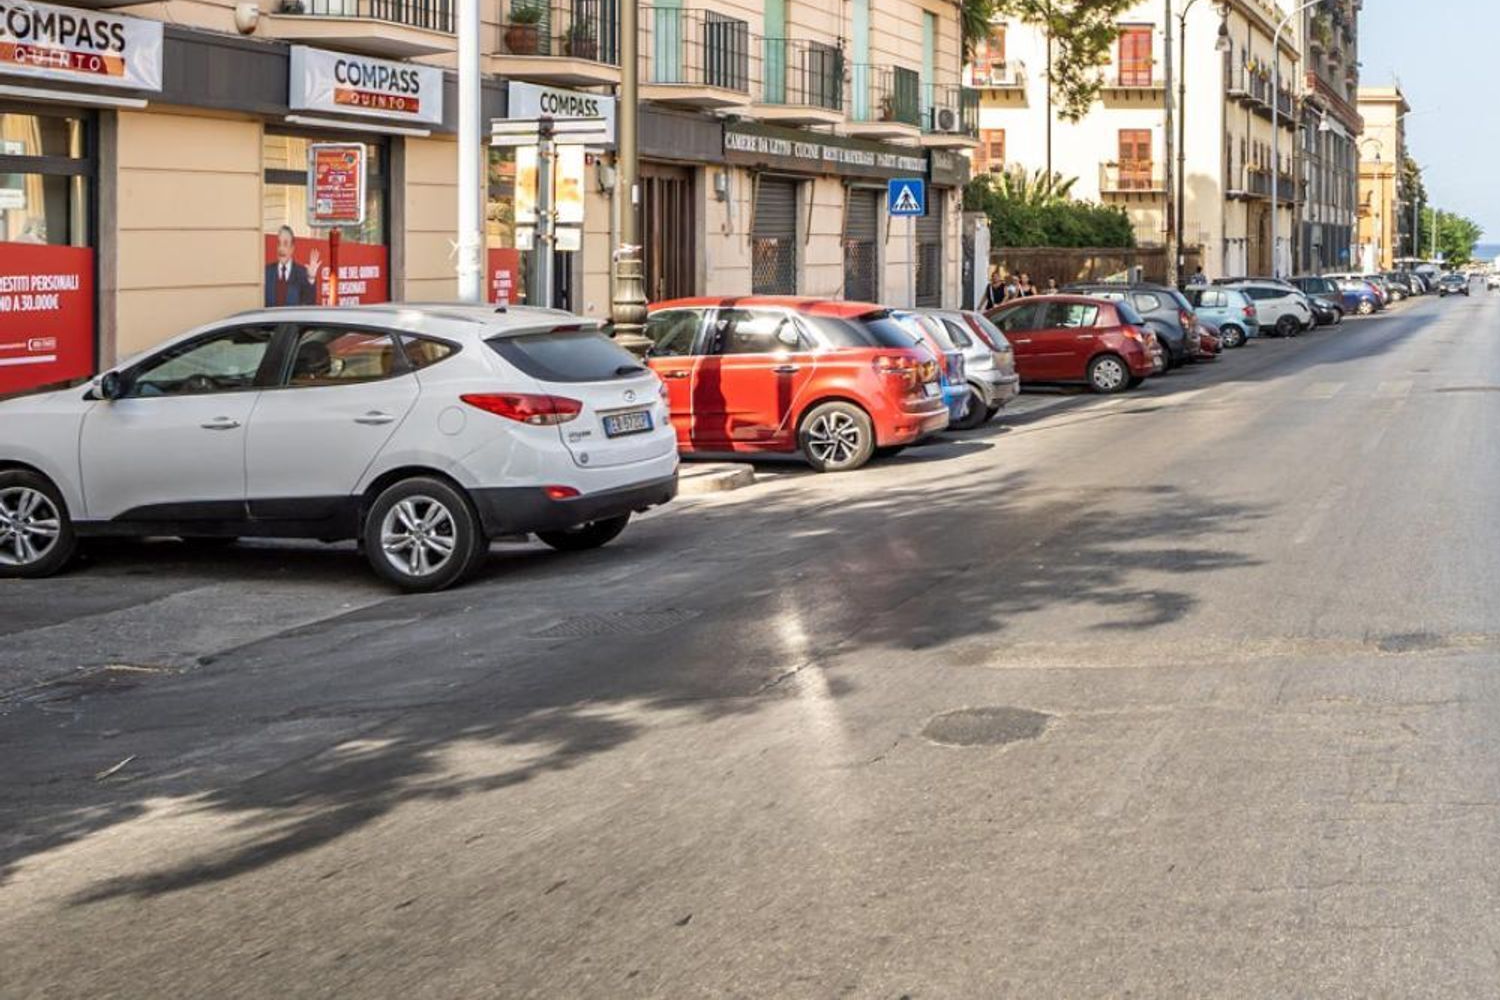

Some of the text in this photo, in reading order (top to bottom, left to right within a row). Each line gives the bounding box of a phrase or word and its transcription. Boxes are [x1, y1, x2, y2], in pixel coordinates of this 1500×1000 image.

[15, 46, 101, 72] QUINTO
[334, 59, 420, 95] COMPASS
[350, 92, 405, 110] QUINTO
[540, 92, 599, 117] COMPASS
[31, 273, 79, 292] PERSONALI
